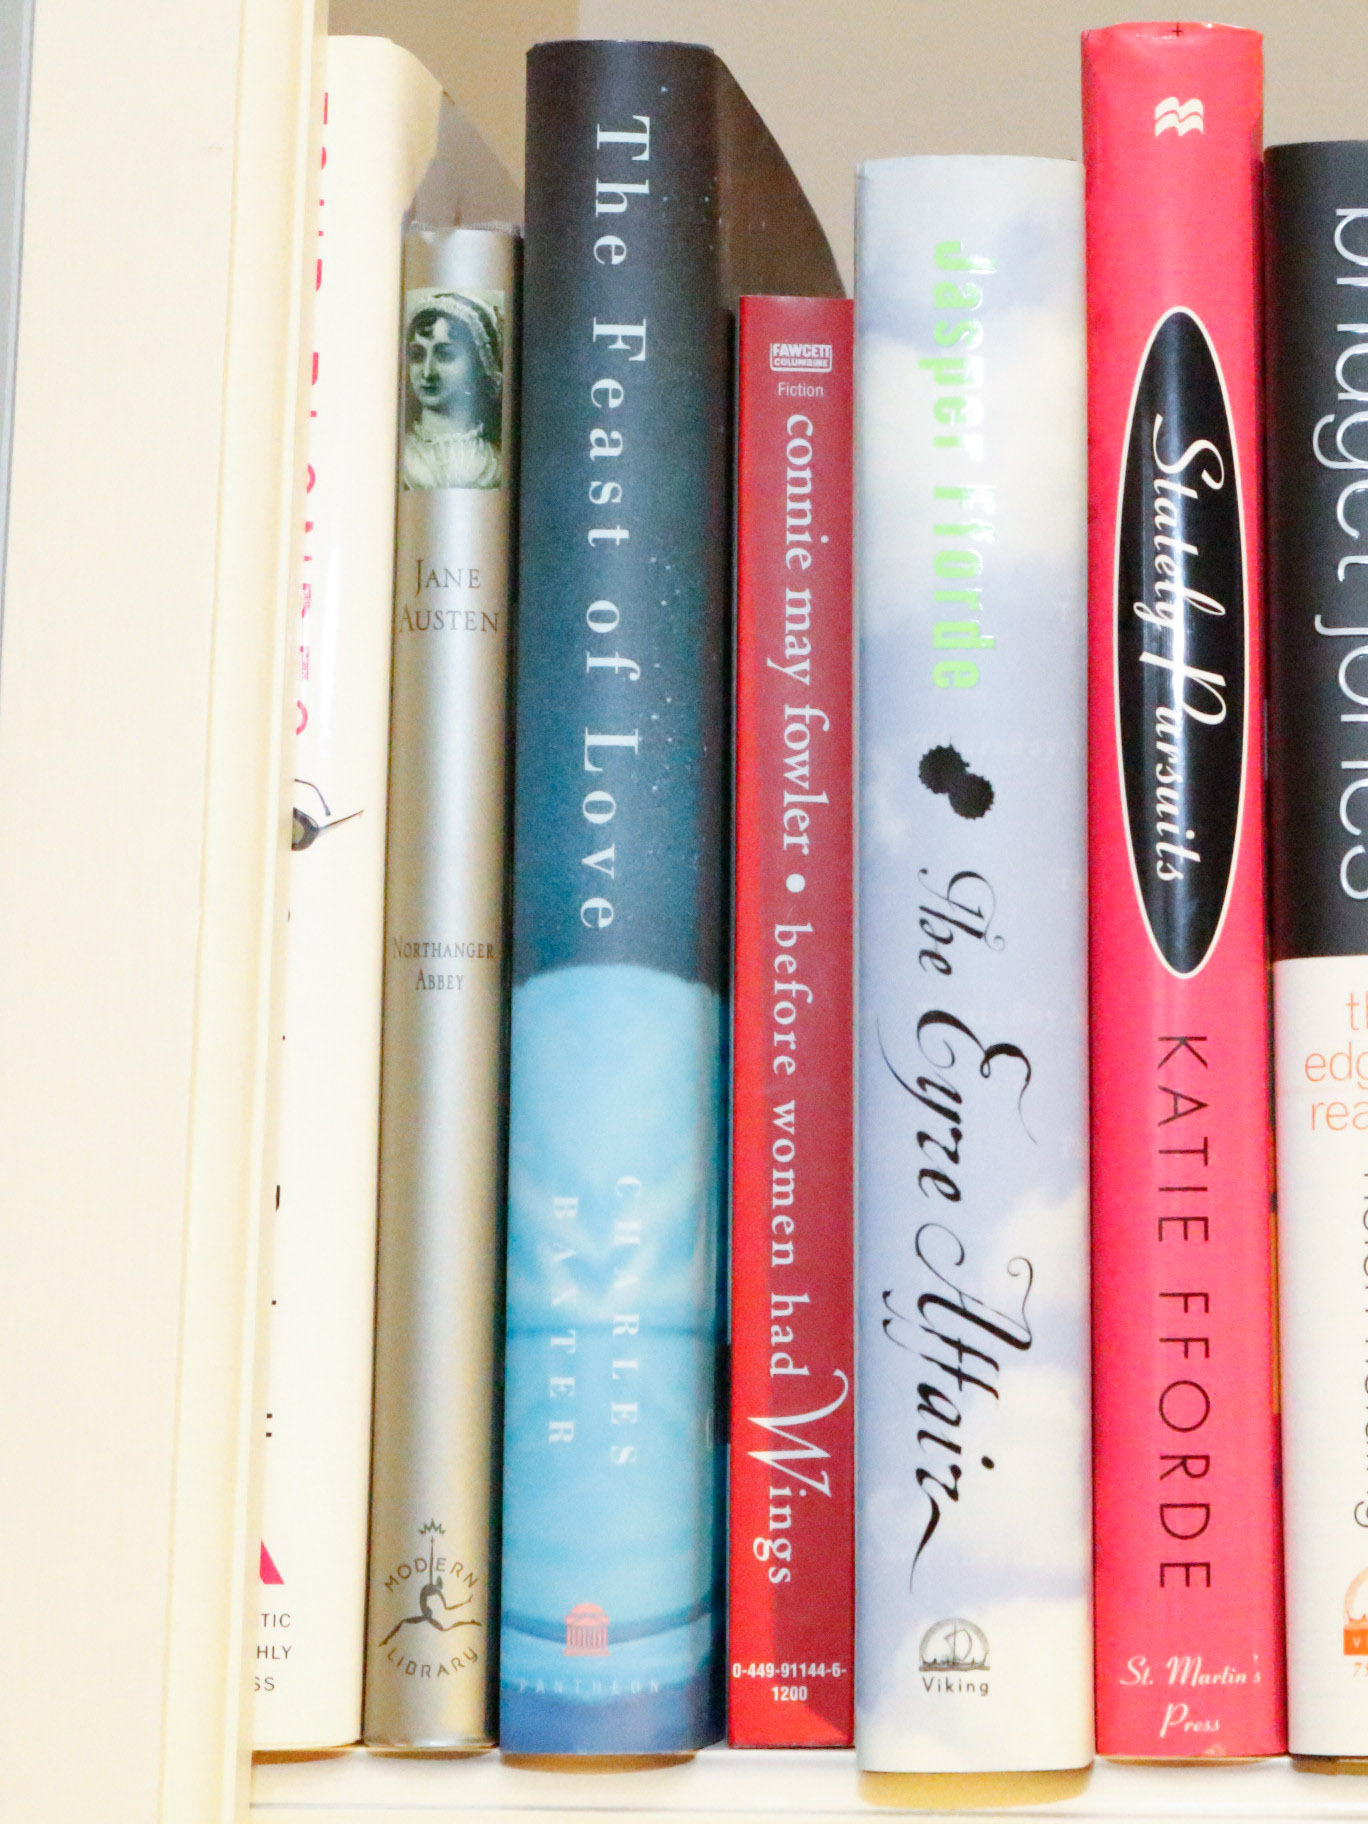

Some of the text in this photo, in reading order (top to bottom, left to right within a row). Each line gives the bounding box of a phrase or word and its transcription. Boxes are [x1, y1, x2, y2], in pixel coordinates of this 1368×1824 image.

[772, 344, 832, 358] FAWCETT
[778, 382, 824, 398] Fiction
[580, 115, 650, 930] The Feast of Love
[414, 559, 481, 598] JANE
[399, 603, 499, 633] AUSTEN
[1133, 413, 1228, 882] Stately Pursuits
[916, 869, 1006, 976] The
[392, 937, 497, 960] NORTHANGER
[415, 967, 465, 991] ABBEY
[747, 414, 850, 1585] connie may fowler before women had Wings
[876, 1008, 1038, 1203] Eyre
[548, 1195, 579, 1444] BAXTER
[610, 1175, 642, 1465] CHARLES
[1157, 1035, 1212, 1590] KATIE FFORDE
[881, 1222, 1034, 1594] Affair
[384, 1557, 478, 1592] MODERN
[387, 1647, 479, 1679] LIBRARY
[1119, 1653, 1262, 1688] St. Martin's
[771, 1685, 808, 1702] 1200
[922, 1676, 989, 1696] Viking
[1159, 1703, 1221, 1739] Press
